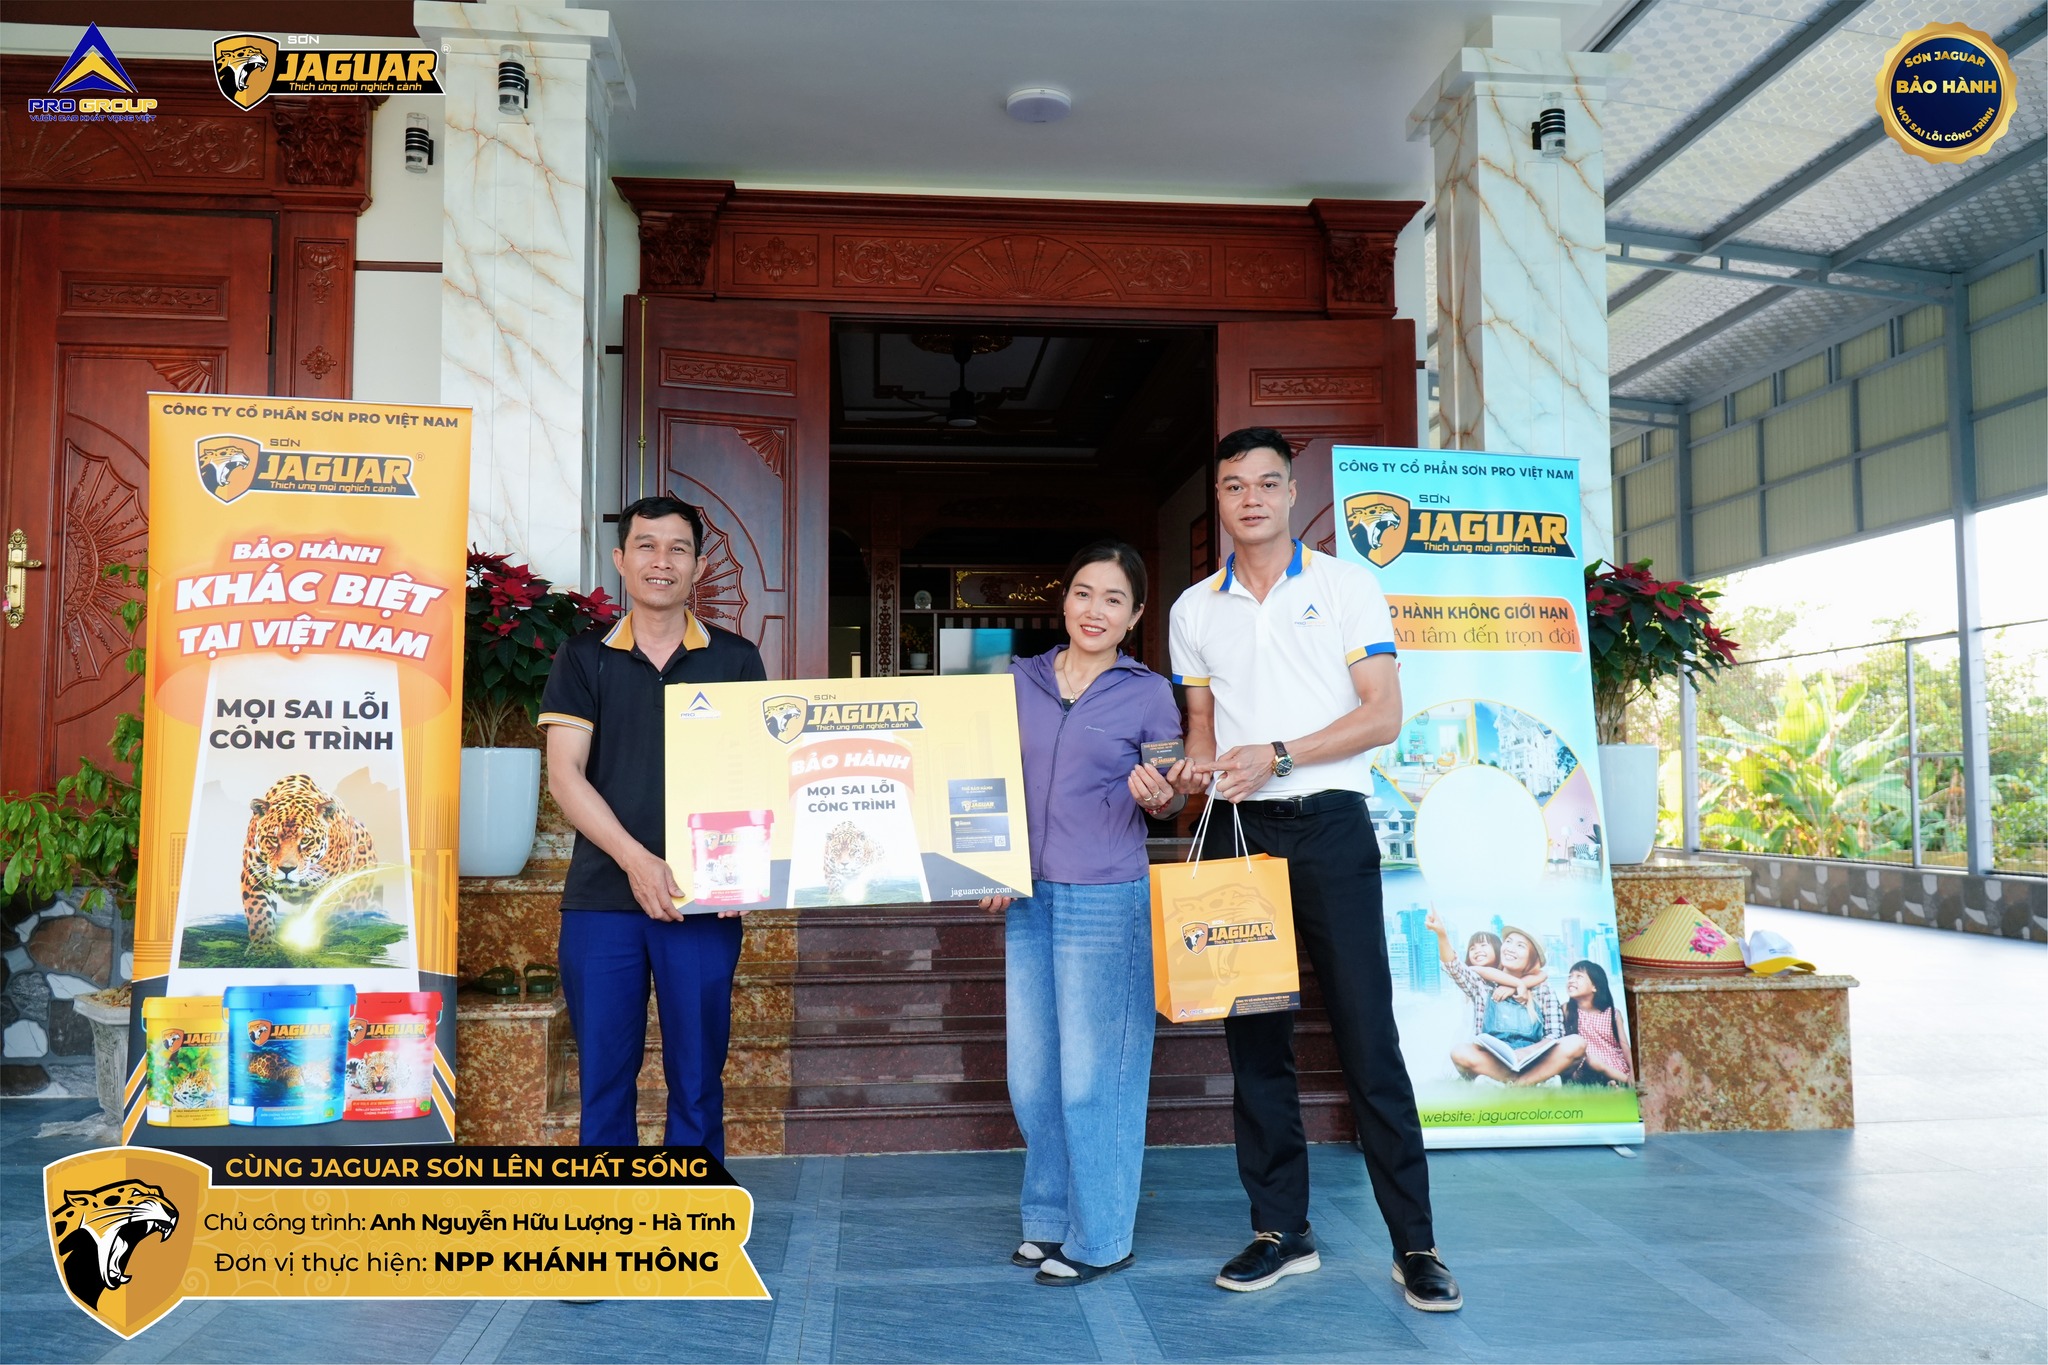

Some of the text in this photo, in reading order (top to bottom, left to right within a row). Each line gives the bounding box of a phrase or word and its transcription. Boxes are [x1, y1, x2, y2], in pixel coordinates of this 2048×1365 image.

[162, 402, 208, 416] CÔNG
[212, 406, 232, 416] TY
[311, 409, 343, 422] SƠN
[348, 412, 381, 424] PRO
[385, 412, 420, 429] VIỆT
[423, 416, 459, 428] NAM
[269, 438, 300, 447] SƠN
[258, 454, 411, 485] JAGUAR
[1339, 459, 1573, 480] CÔNG TY CỔ PHẦN SƠN PRO VIỆT NAM
[319, 483, 337, 492] mọi
[338, 484, 371, 494] nghịch
[1419, 494, 1450, 503] SƠN
[1411, 512, 1566, 545] JAGUAR
[232, 537, 381, 563] BẢO HÀNH
[1475, 544, 1492, 553] mọi
[1496, 544, 1529, 554] nghịch
[177, 564, 444, 618] KHÁC BIỆT
[1403, 602, 1443, 619] HÀNH
[1448, 603, 1500, 619] KHÔNG
[1504, 603, 1535, 619] GIỚI
[1540, 606, 1568, 622] HẠN
[180, 615, 431, 659] TẠI VIỆT NAM
[1422, 627, 1456, 643] tâm
[1464, 624, 1498, 643] đến
[1506, 629, 1542, 646] trọn
[1549, 628, 1575, 644] đời
[217, 691, 388, 724] MỌI SAI LỖI
[807, 703, 917, 725] JAGUAR
[209, 725, 393, 750] CÔNG TRÌNH
[791, 752, 839, 776] BẢO
[807, 779, 895, 798] MỌI SAI LỖI
[808, 798, 896, 813] CÔNG TRÌNH
[950, 886, 1012, 898] jaguarcolor.com
[1209, 923, 1272, 941] JAGUAR
[271, 1024, 330, 1037] JAGUAR
[367, 1024, 425, 1036] JAGUAR
[1423, 1108, 1583, 1124] website: jaguarcolor.com
